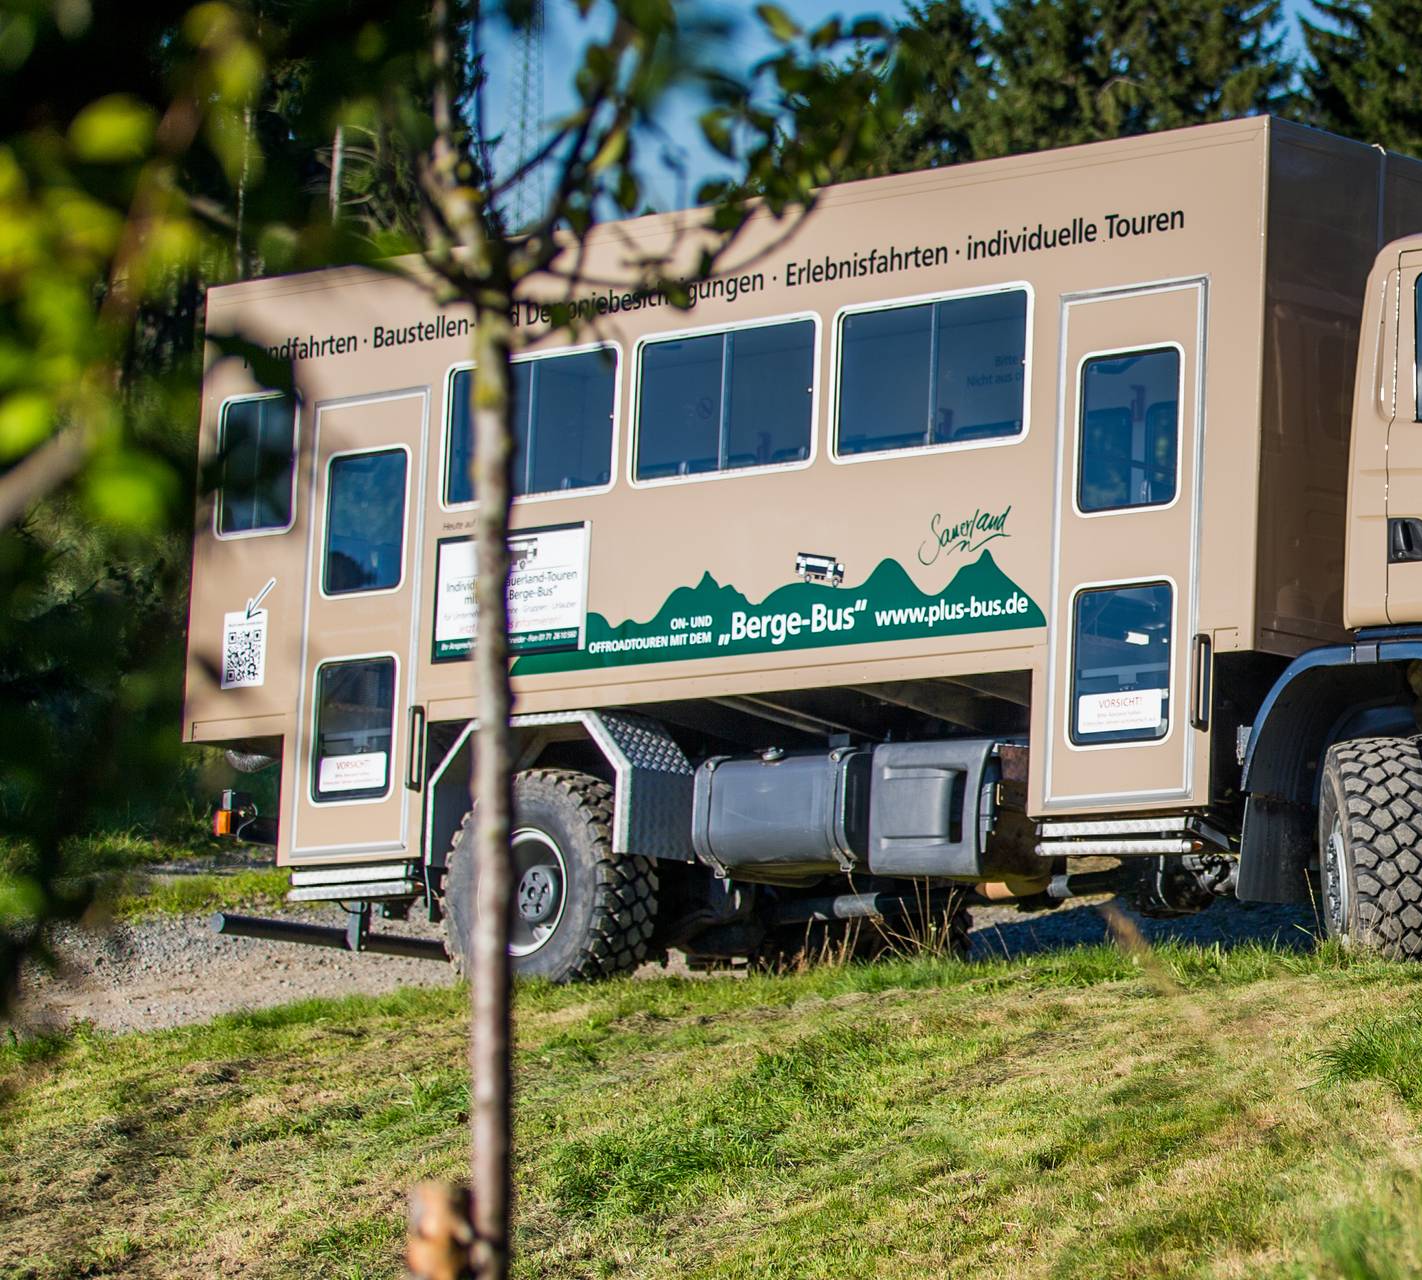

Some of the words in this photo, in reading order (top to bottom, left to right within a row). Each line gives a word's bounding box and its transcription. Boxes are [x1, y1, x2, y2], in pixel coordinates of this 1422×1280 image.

[243, 333, 357, 369] ndfahrten
[373, 316, 475, 348] Baustellen-
[526, 272, 764, 327] Deoniebesichgungen
[786, 245, 948, 287] Erlebnisfahrten
[967, 216, 1097, 260] individuelle
[1104, 209, 1185, 239] Touren
[917, 505, 1012, 566] Sauerland
[507, 570, 577, 587] auerland-Touren
[670, 617, 689, 630] ON-
[690, 615, 713, 628] UND
[875, 591, 1029, 627] www.plus-bus.de
[588, 635, 669, 654] OFFROADTOUREN
[669, 633, 688, 646] MIT
[689, 631, 712, 645] DEM
